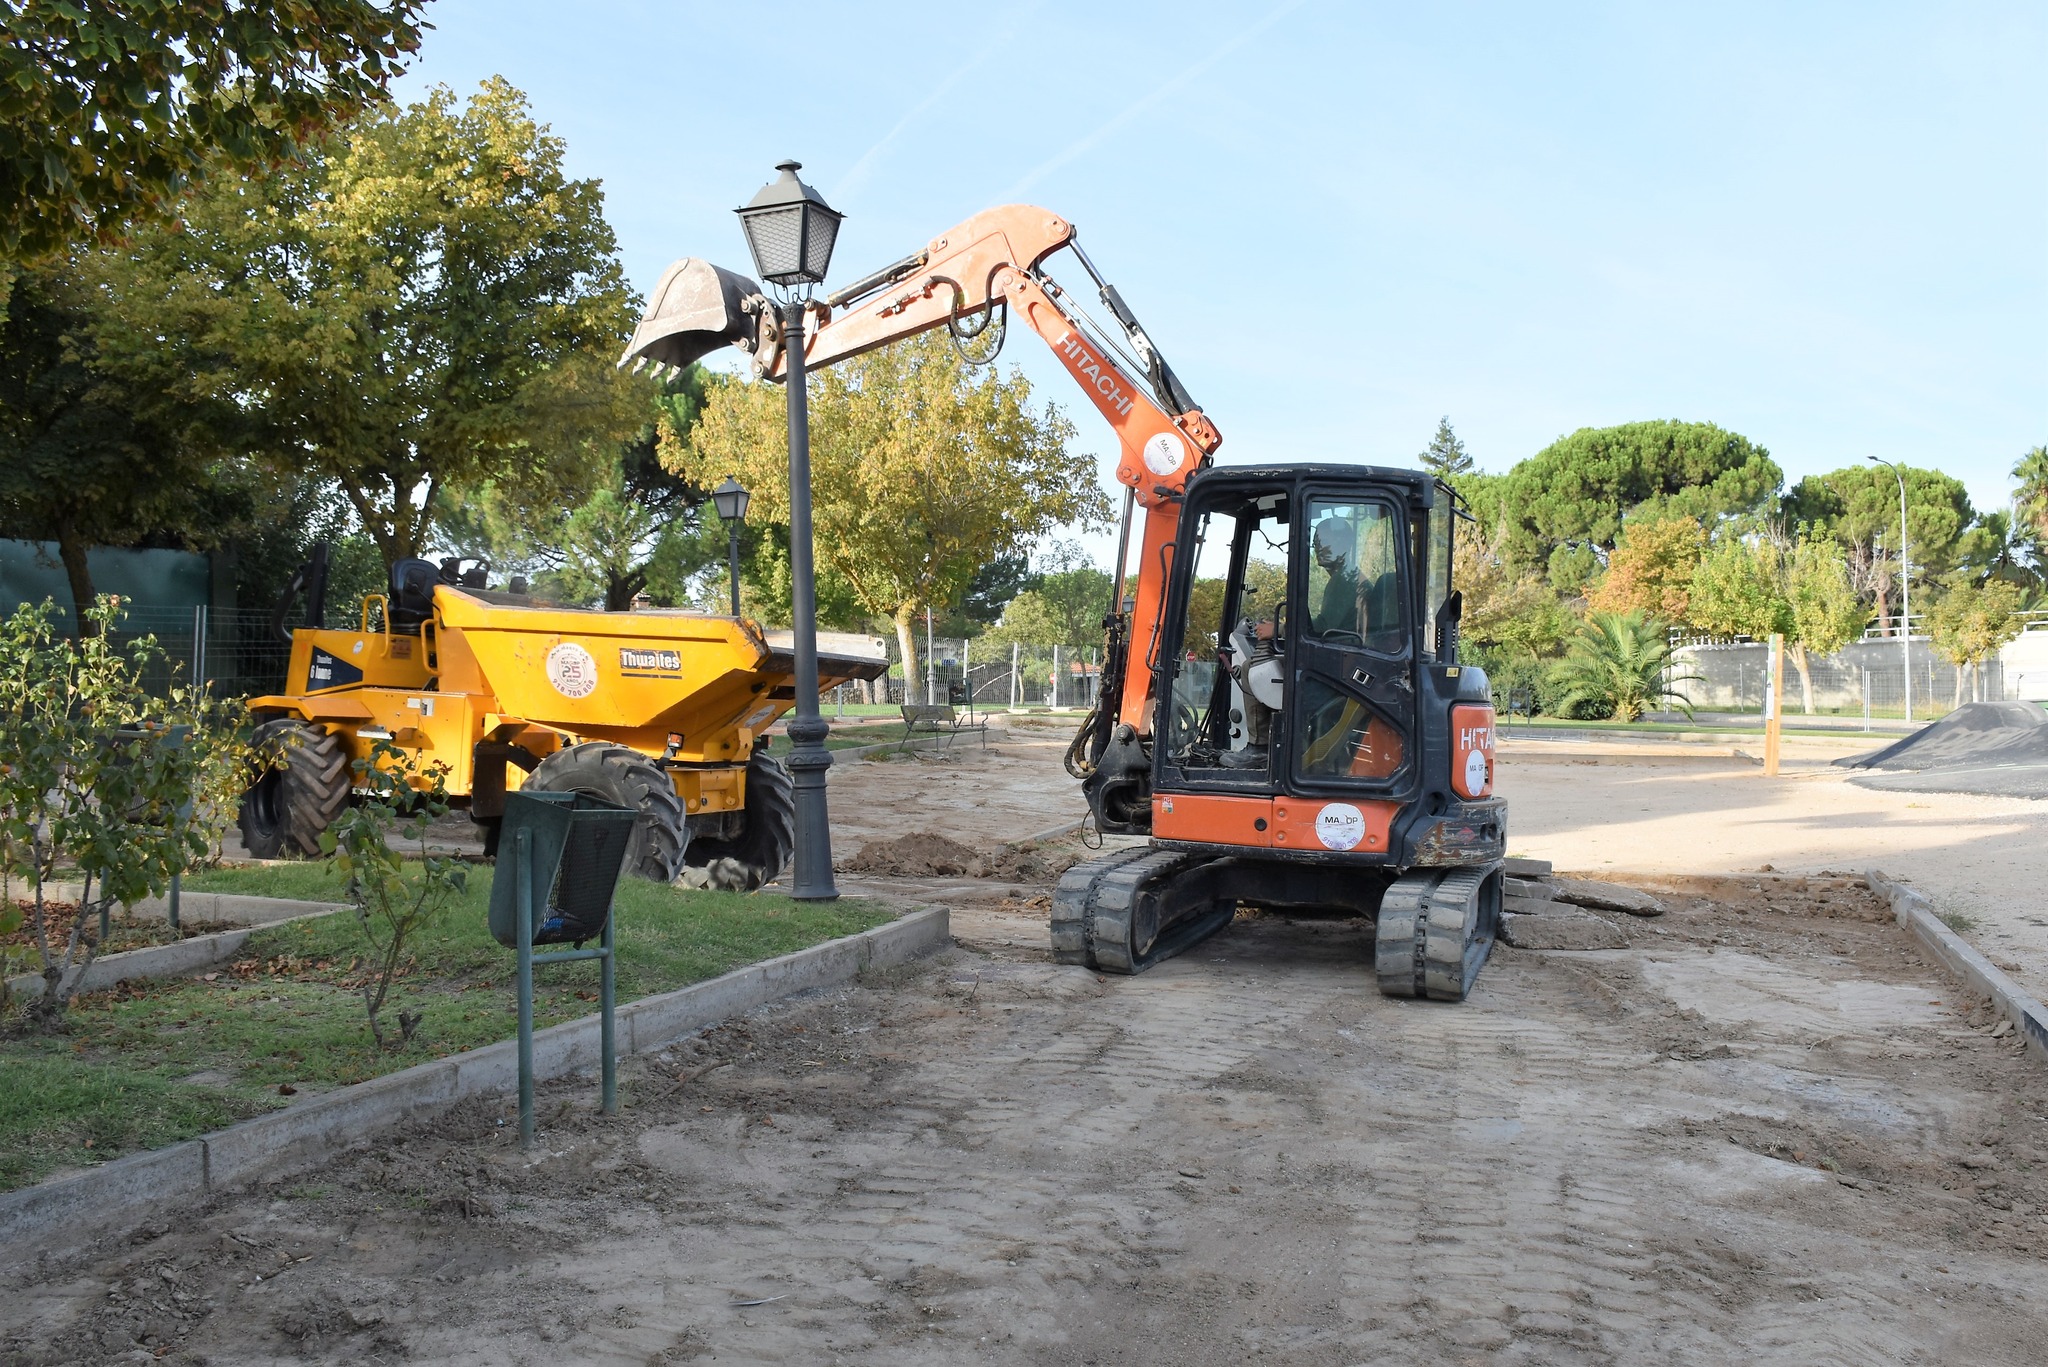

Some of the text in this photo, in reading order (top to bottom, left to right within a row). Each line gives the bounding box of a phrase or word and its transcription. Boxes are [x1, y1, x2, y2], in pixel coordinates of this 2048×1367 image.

[1056, 331, 1134, 416] HITACHI
[622, 651, 680, 669] Thwaites
[310, 664, 315, 679] 6
[562, 665, 581, 678] 25
[553, 678, 565, 693] 918
[568, 689, 582, 697] 700
[1324, 815, 1358, 824] MAOP
